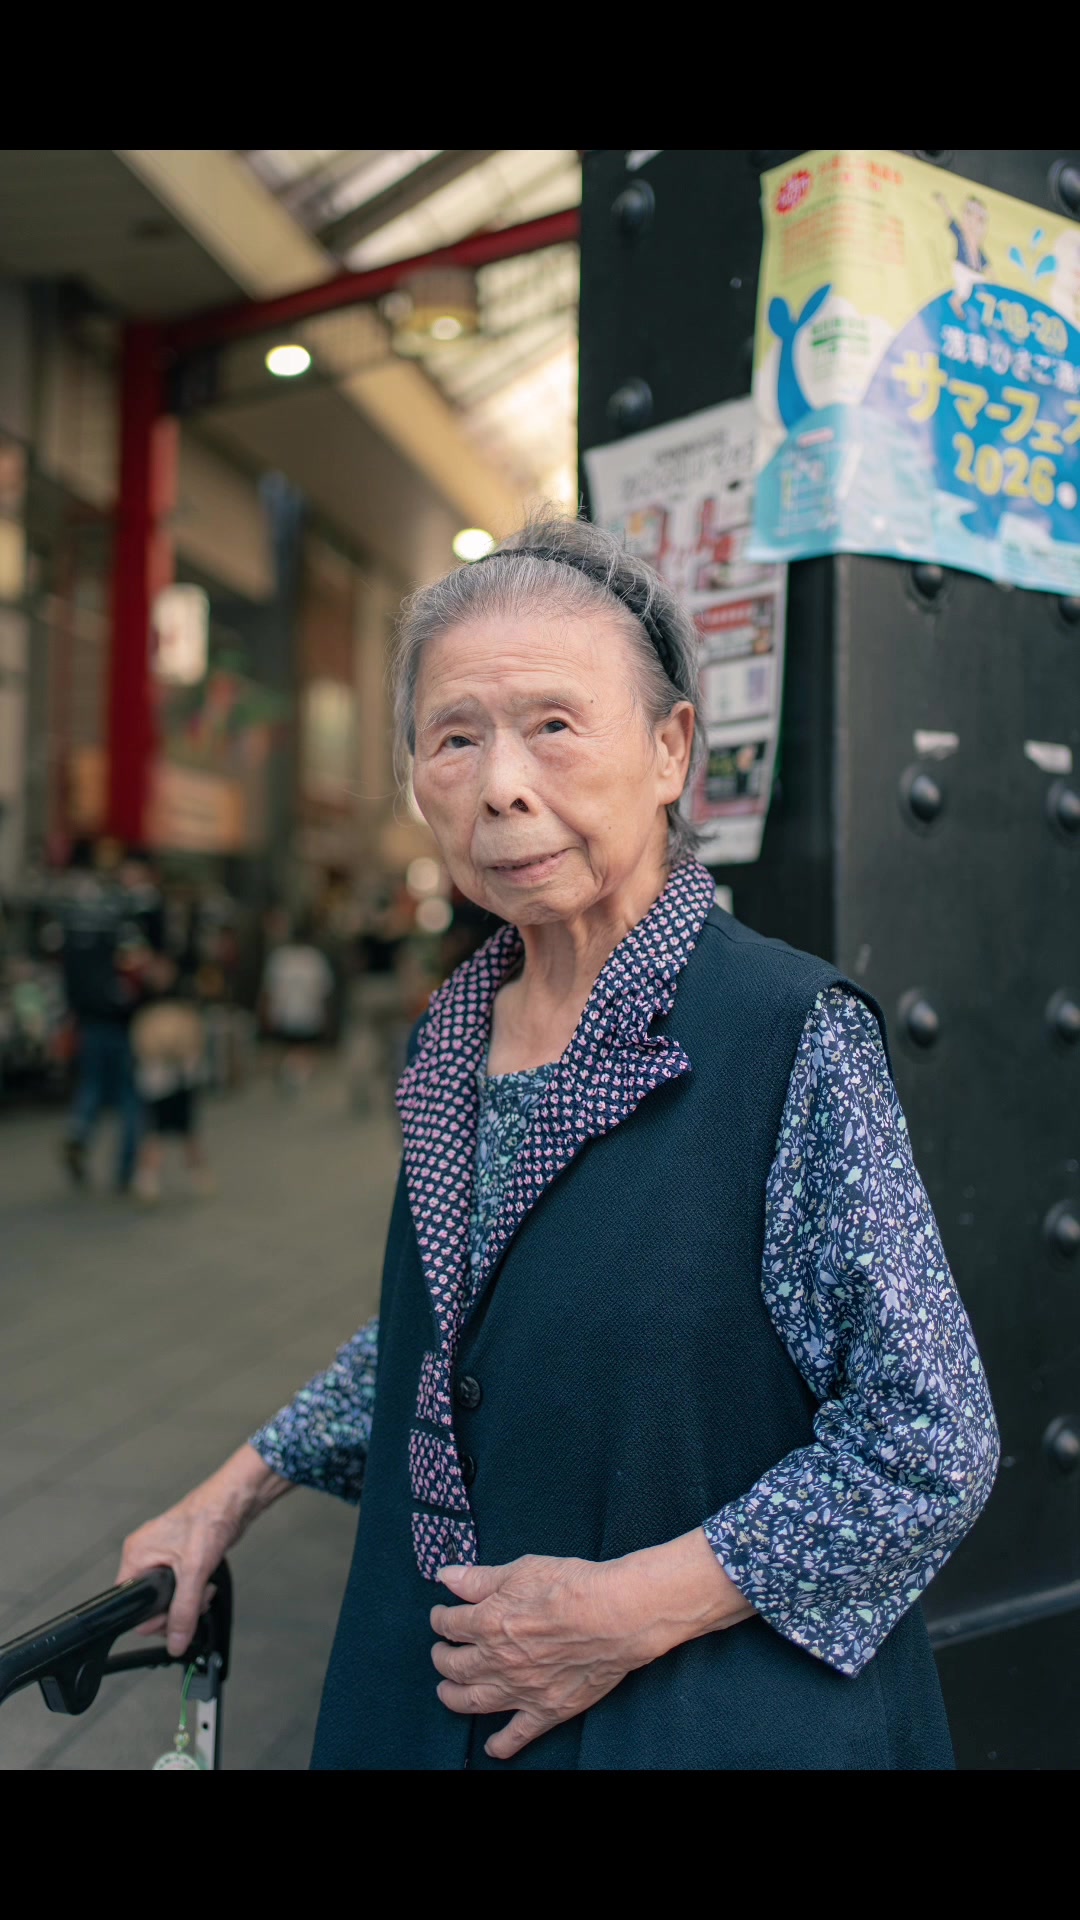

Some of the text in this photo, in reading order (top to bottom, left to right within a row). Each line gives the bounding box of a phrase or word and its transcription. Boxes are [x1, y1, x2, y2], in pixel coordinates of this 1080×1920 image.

[941, 324, 1080, 394] 浅草ひさご通
[952, 432, 1057, 506] 2026
